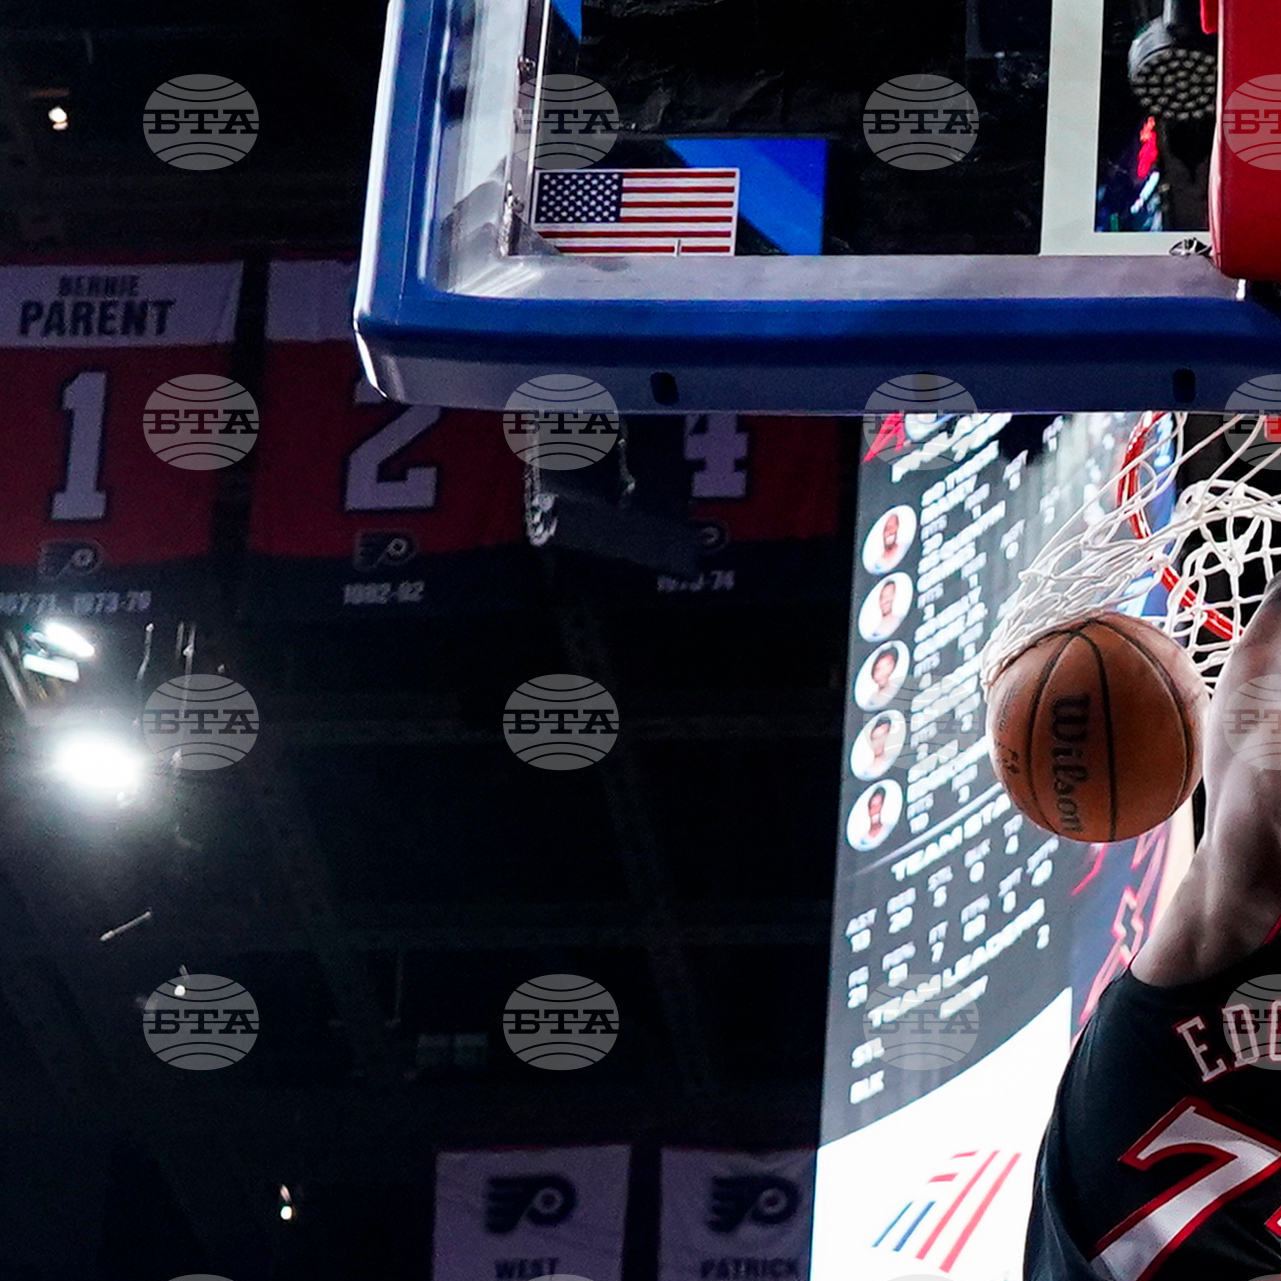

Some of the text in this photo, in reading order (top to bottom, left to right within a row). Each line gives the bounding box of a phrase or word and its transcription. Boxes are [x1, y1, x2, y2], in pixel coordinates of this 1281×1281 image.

[19, 298, 176, 337] PARENT
[51, 371, 107, 520] 1
[1051, 694, 1092, 834] Wilson
